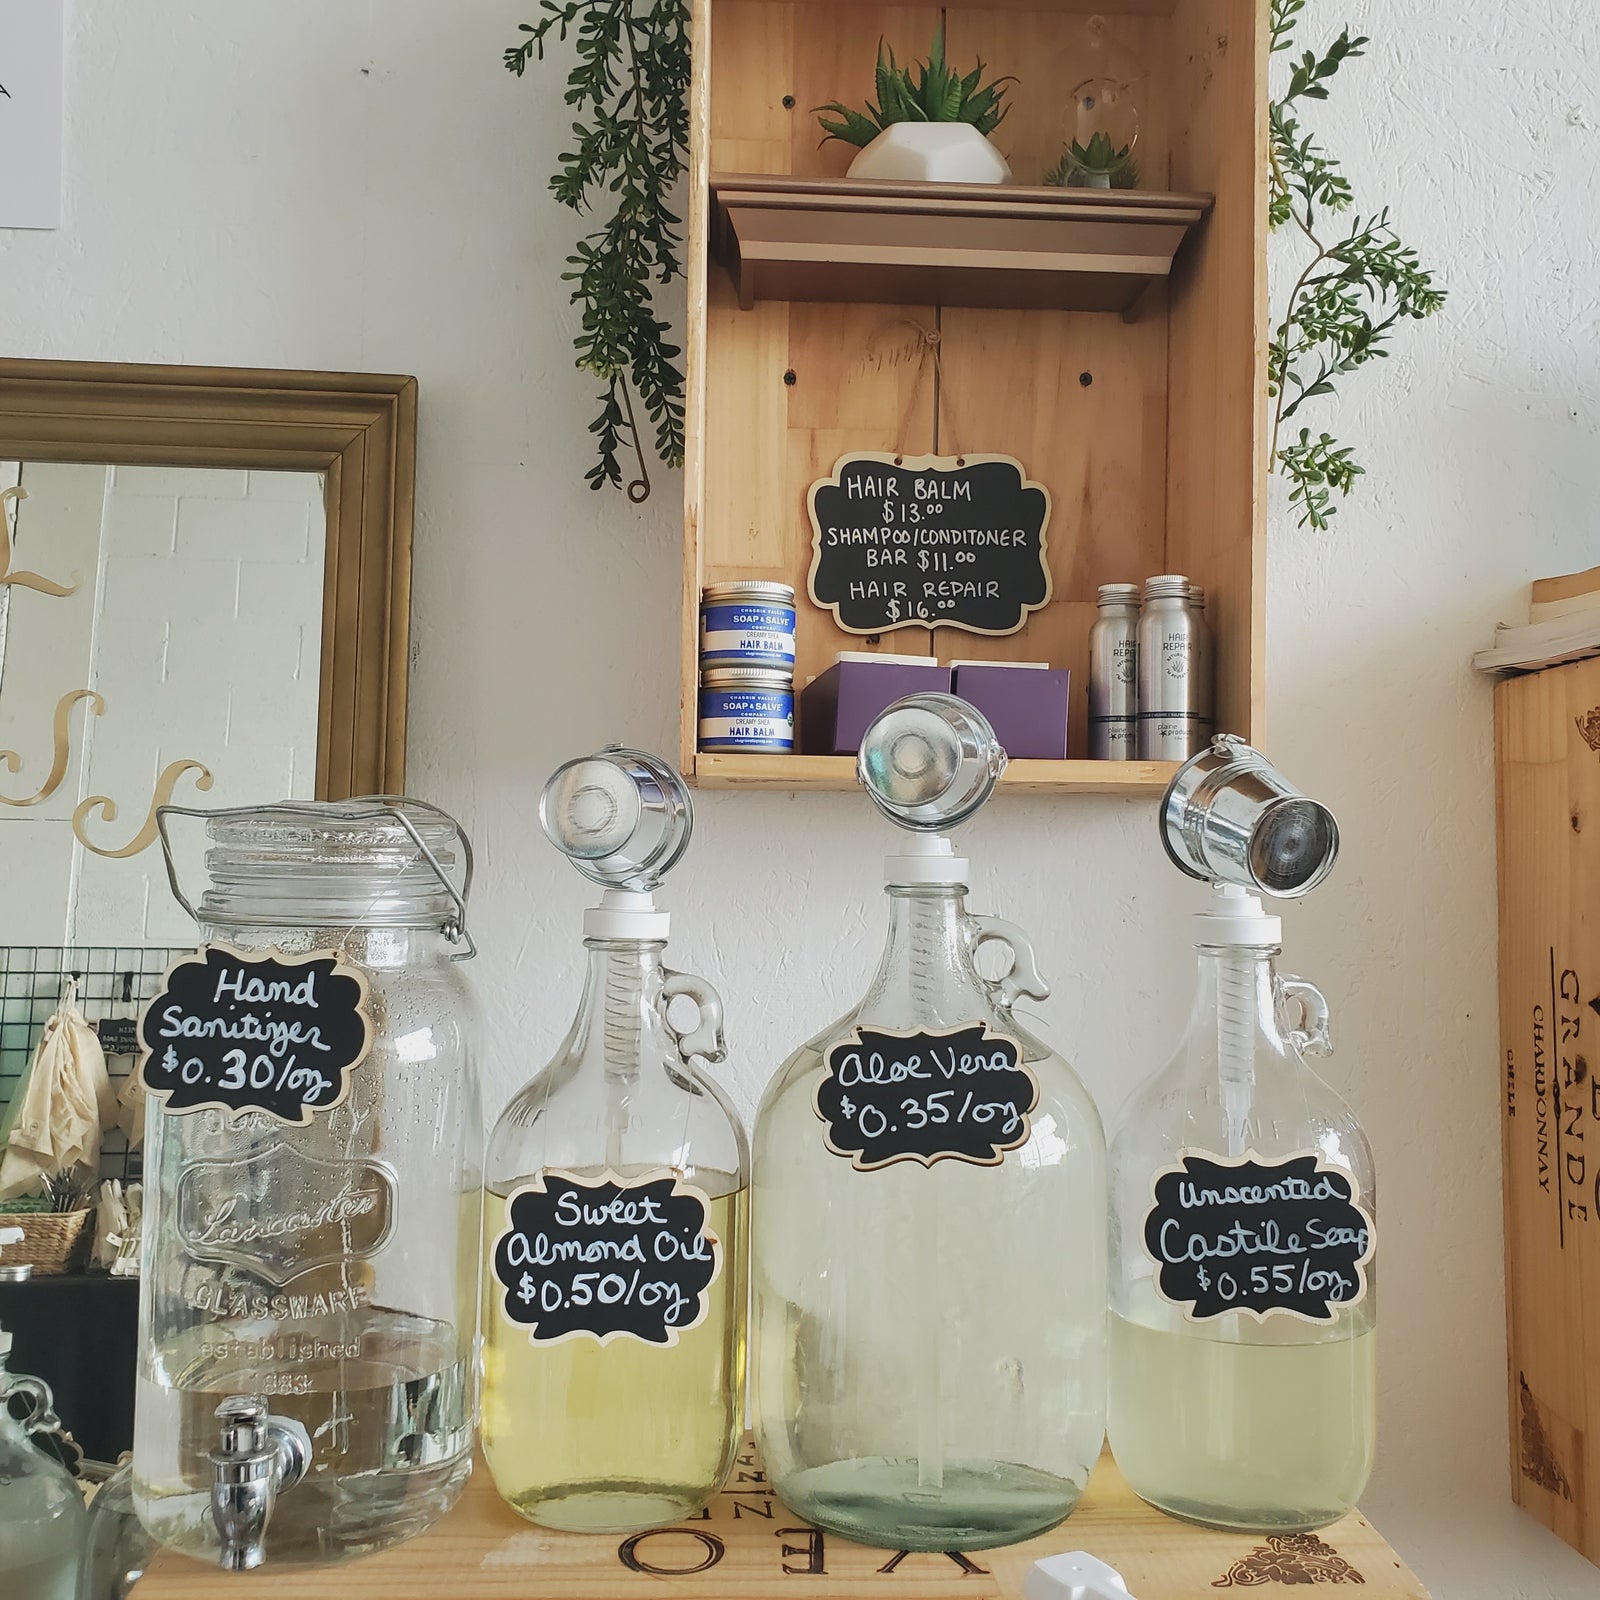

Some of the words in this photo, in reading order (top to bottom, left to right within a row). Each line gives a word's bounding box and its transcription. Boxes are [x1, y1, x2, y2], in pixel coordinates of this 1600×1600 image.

[848, 475, 899, 499] HAIR
[914, 478, 972, 501] BALM
[882, 500, 943, 523] $13.00
[827, 527, 1027, 547] SHAMPOO/CONDITONER
[867, 549, 908, 568] BAR
[917, 550, 976, 572] $11.00
[850, 581, 907, 600] HAIR
[923, 581, 1000, 599] REPAIR
[733, 615, 759, 623] SOAP
[765, 616, 788, 626] SALVE
[886, 599, 956, 622] $16.00
[740, 640, 761, 649] HAIR
[763, 641, 784, 650] BALM
[1113, 648, 1136, 657] REPA
[1163, 642, 1192, 651] REPAR
[722, 702, 748, 710] SOAP
[755, 702, 781, 712] SALVE
[729, 727, 750, 736] HAIR
[753, 727, 775, 737] BALM
[213, 968, 319, 1009] Hand
[159, 1005, 332, 1057] Sanitizer
[162, 1044, 333, 1103] $0.30/oz
[838, 1053, 932, 1087] Aloe
[929, 1046, 1019, 1080] Vera
[1506, 1048, 1516, 1118] CHILE
[1532, 1004, 1551, 1195] CHARDONNAY
[1560, 968, 1588, 1223] GRANDE
[840, 1090, 1020, 1138] $0.35/oz
[554, 1190, 668, 1226] Sweet
[1179, 1176, 1347, 1208] Unscented
[507, 1232, 647, 1266] Almond
[654, 1227, 712, 1262] Oil
[1160, 1218, 1307, 1264] Castile
[1305, 1218, 1369, 1256] Soap
[517, 1268, 690, 1324] $0.50/oz
[1197, 1258, 1353, 1301] $0.55/oz
